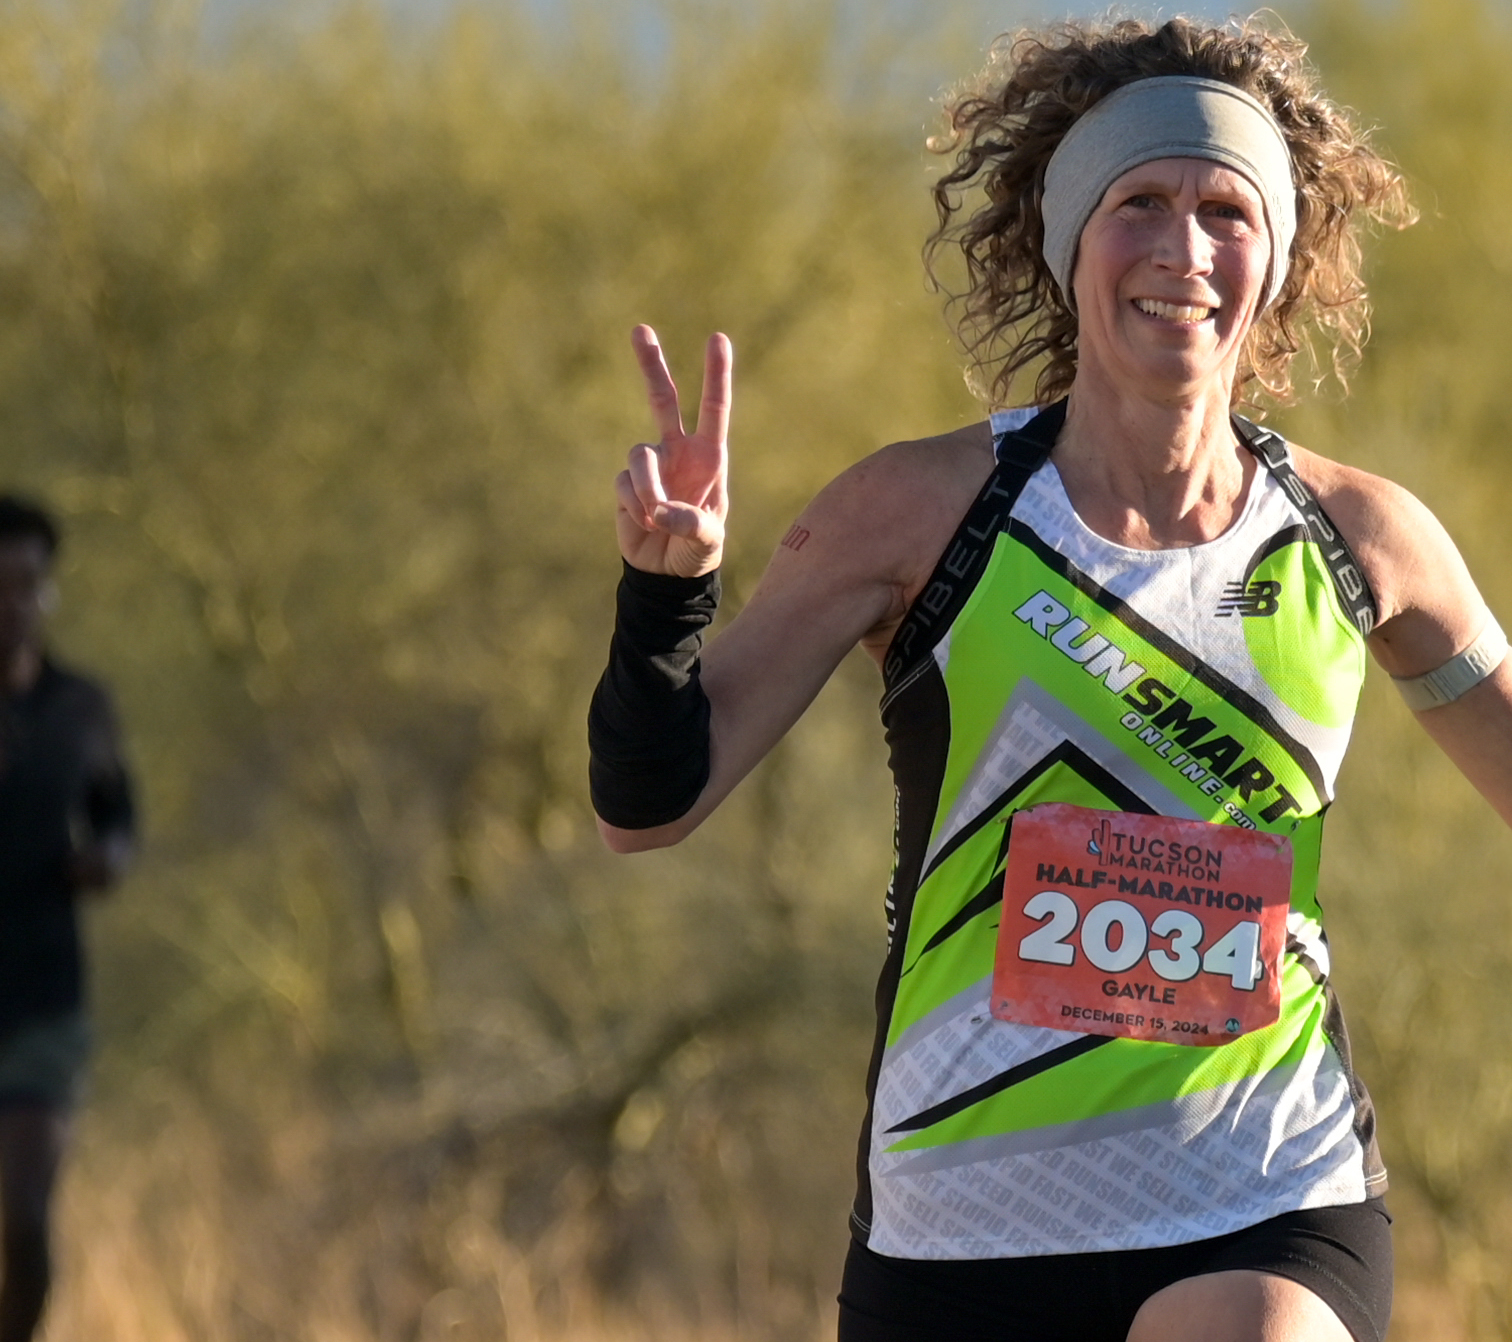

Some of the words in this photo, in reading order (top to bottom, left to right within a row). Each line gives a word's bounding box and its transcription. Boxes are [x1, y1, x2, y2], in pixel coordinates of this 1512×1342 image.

[886, 474, 1009, 684] SPIBELT
[1012, 589, 1303, 824] RUNSMART
[1110, 852, 1221, 883] MARATHON
[1113, 832, 1223, 868] TUCSON
[1036, 863, 1263, 914] HALF-MARATHON
[1017, 889, 1264, 992] 2034
[1101, 979, 1177, 1005] GAYLE
[1060, 1004, 1145, 1027] DECEMBER
[1149, 1016, 1168, 1032] 15,
[1171, 1019, 1210, 1036] 2024
